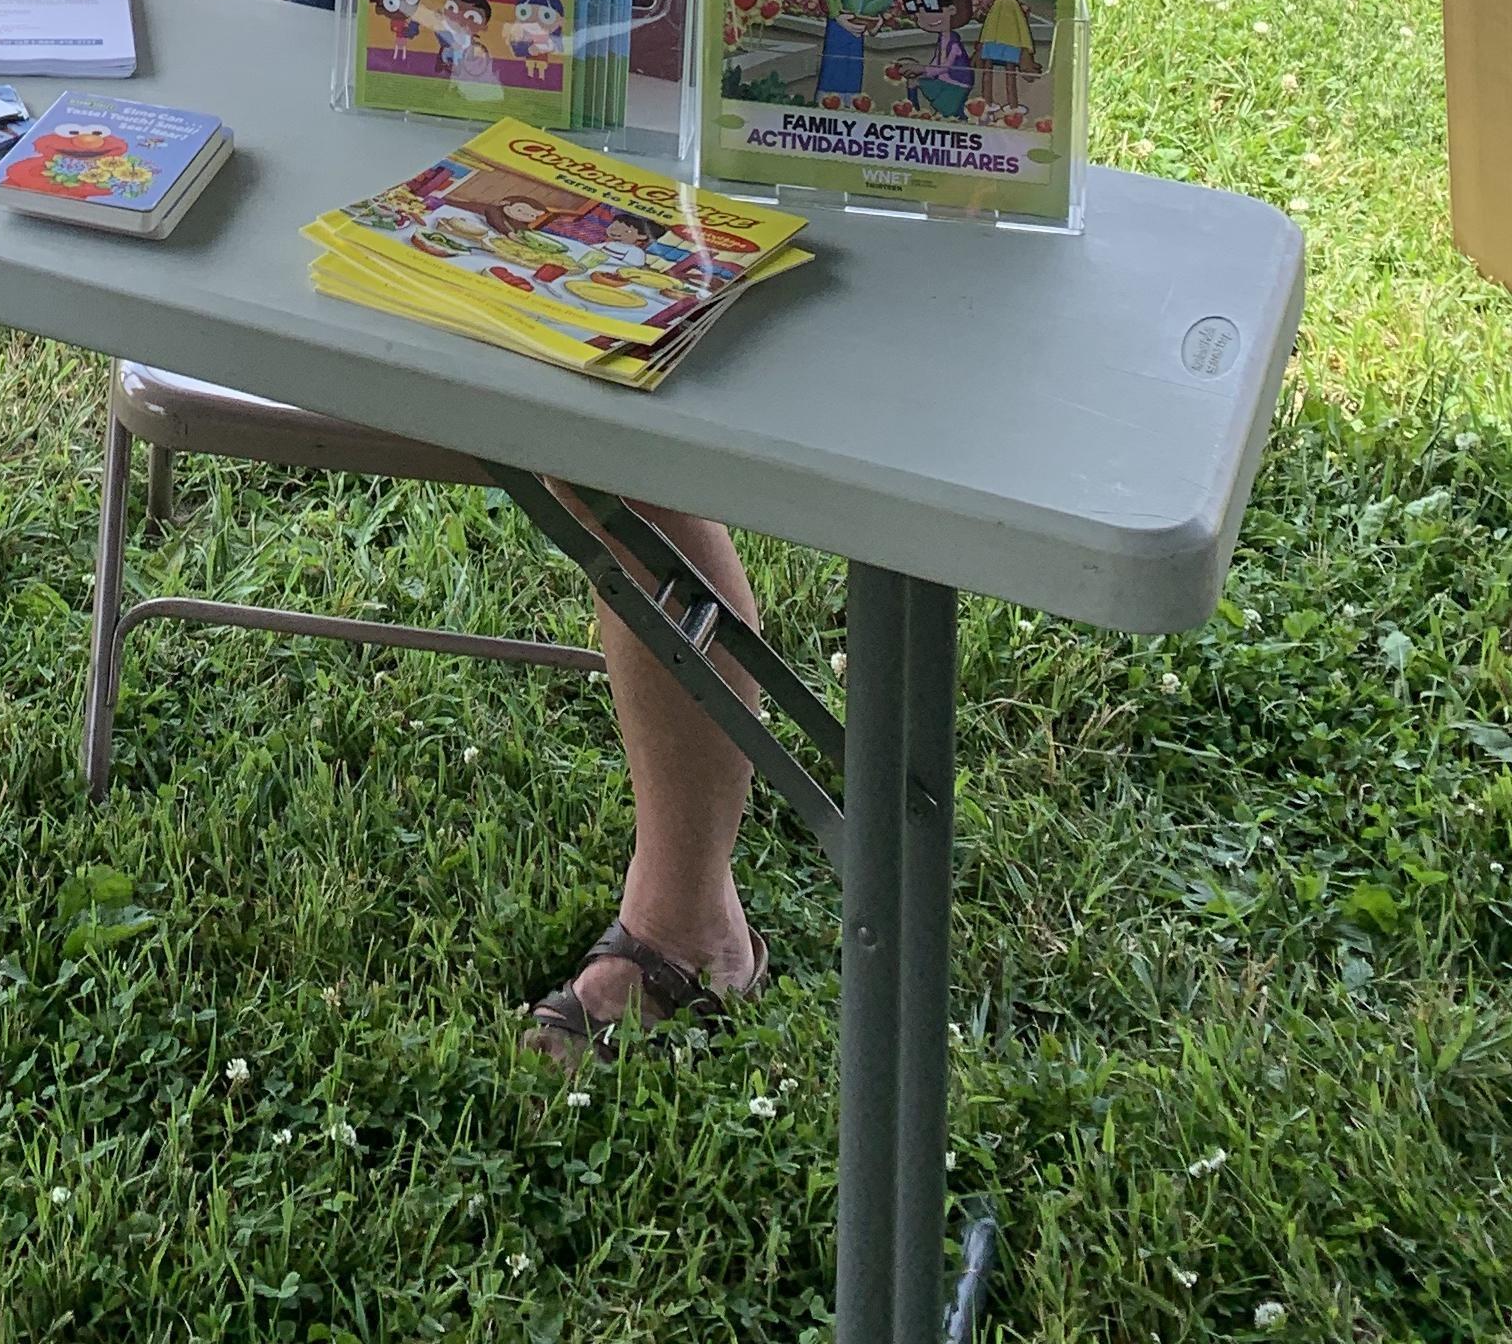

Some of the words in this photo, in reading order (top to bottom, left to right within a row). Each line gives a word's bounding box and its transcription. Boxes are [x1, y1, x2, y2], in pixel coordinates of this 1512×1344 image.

[746, 128, 890, 160] ACTIVIDADES
[894, 143, 1020, 174] FAMILIARES
[783, 113, 857, 137] FAMILY
[863, 122, 983, 151] ACTIVITIES
[509, 139, 636, 194] Curious
[632, 184, 761, 229] Grge
[555, 173, 597, 194] Farm
[602, 191, 621, 202] to
[626, 198, 674, 220] Table
[862, 167, 913, 186] WNET
